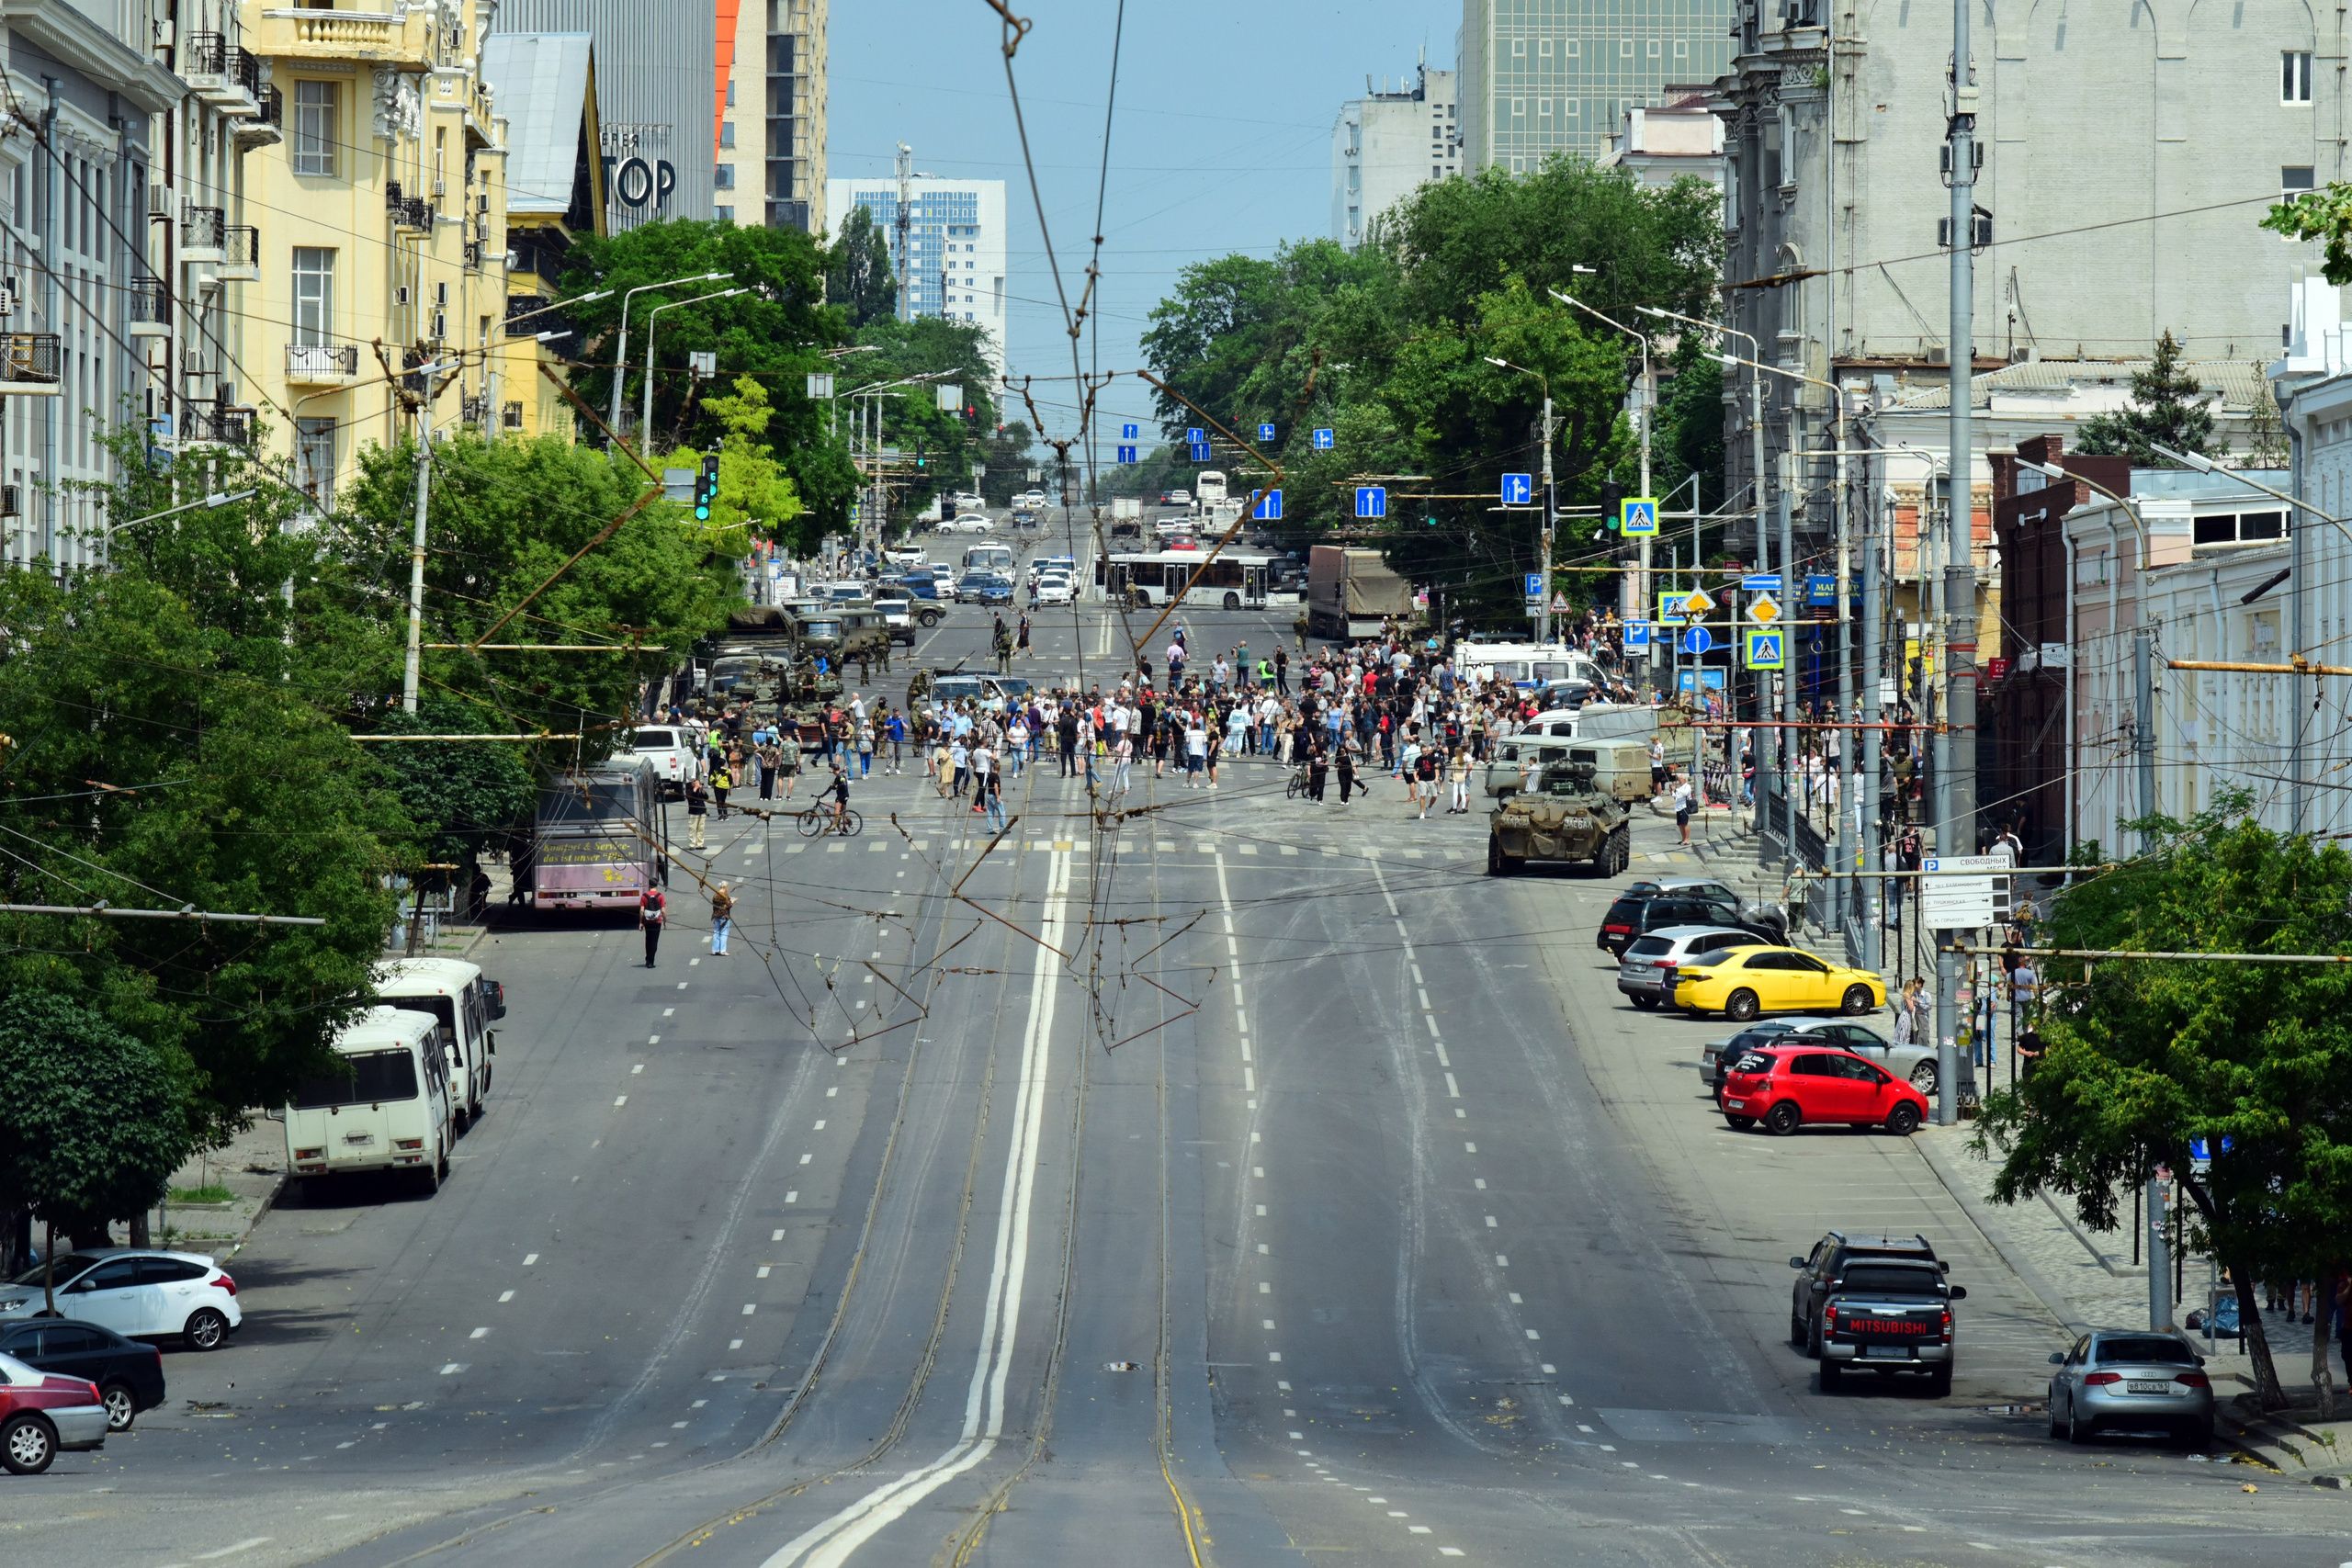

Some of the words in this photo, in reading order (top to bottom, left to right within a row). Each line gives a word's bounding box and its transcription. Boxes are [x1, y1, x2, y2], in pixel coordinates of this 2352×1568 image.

[543, 842, 582, 853] Komfort
[583, 842, 591, 851] &
[594, 841, 630, 851] Service-
[560, 853, 571, 863] ist
[574, 853, 600, 862] unser
[1960, 857, 2007, 865] СВОБОДНЫХ
[1849, 1319, 1927, 1335] MITSUBISHI
